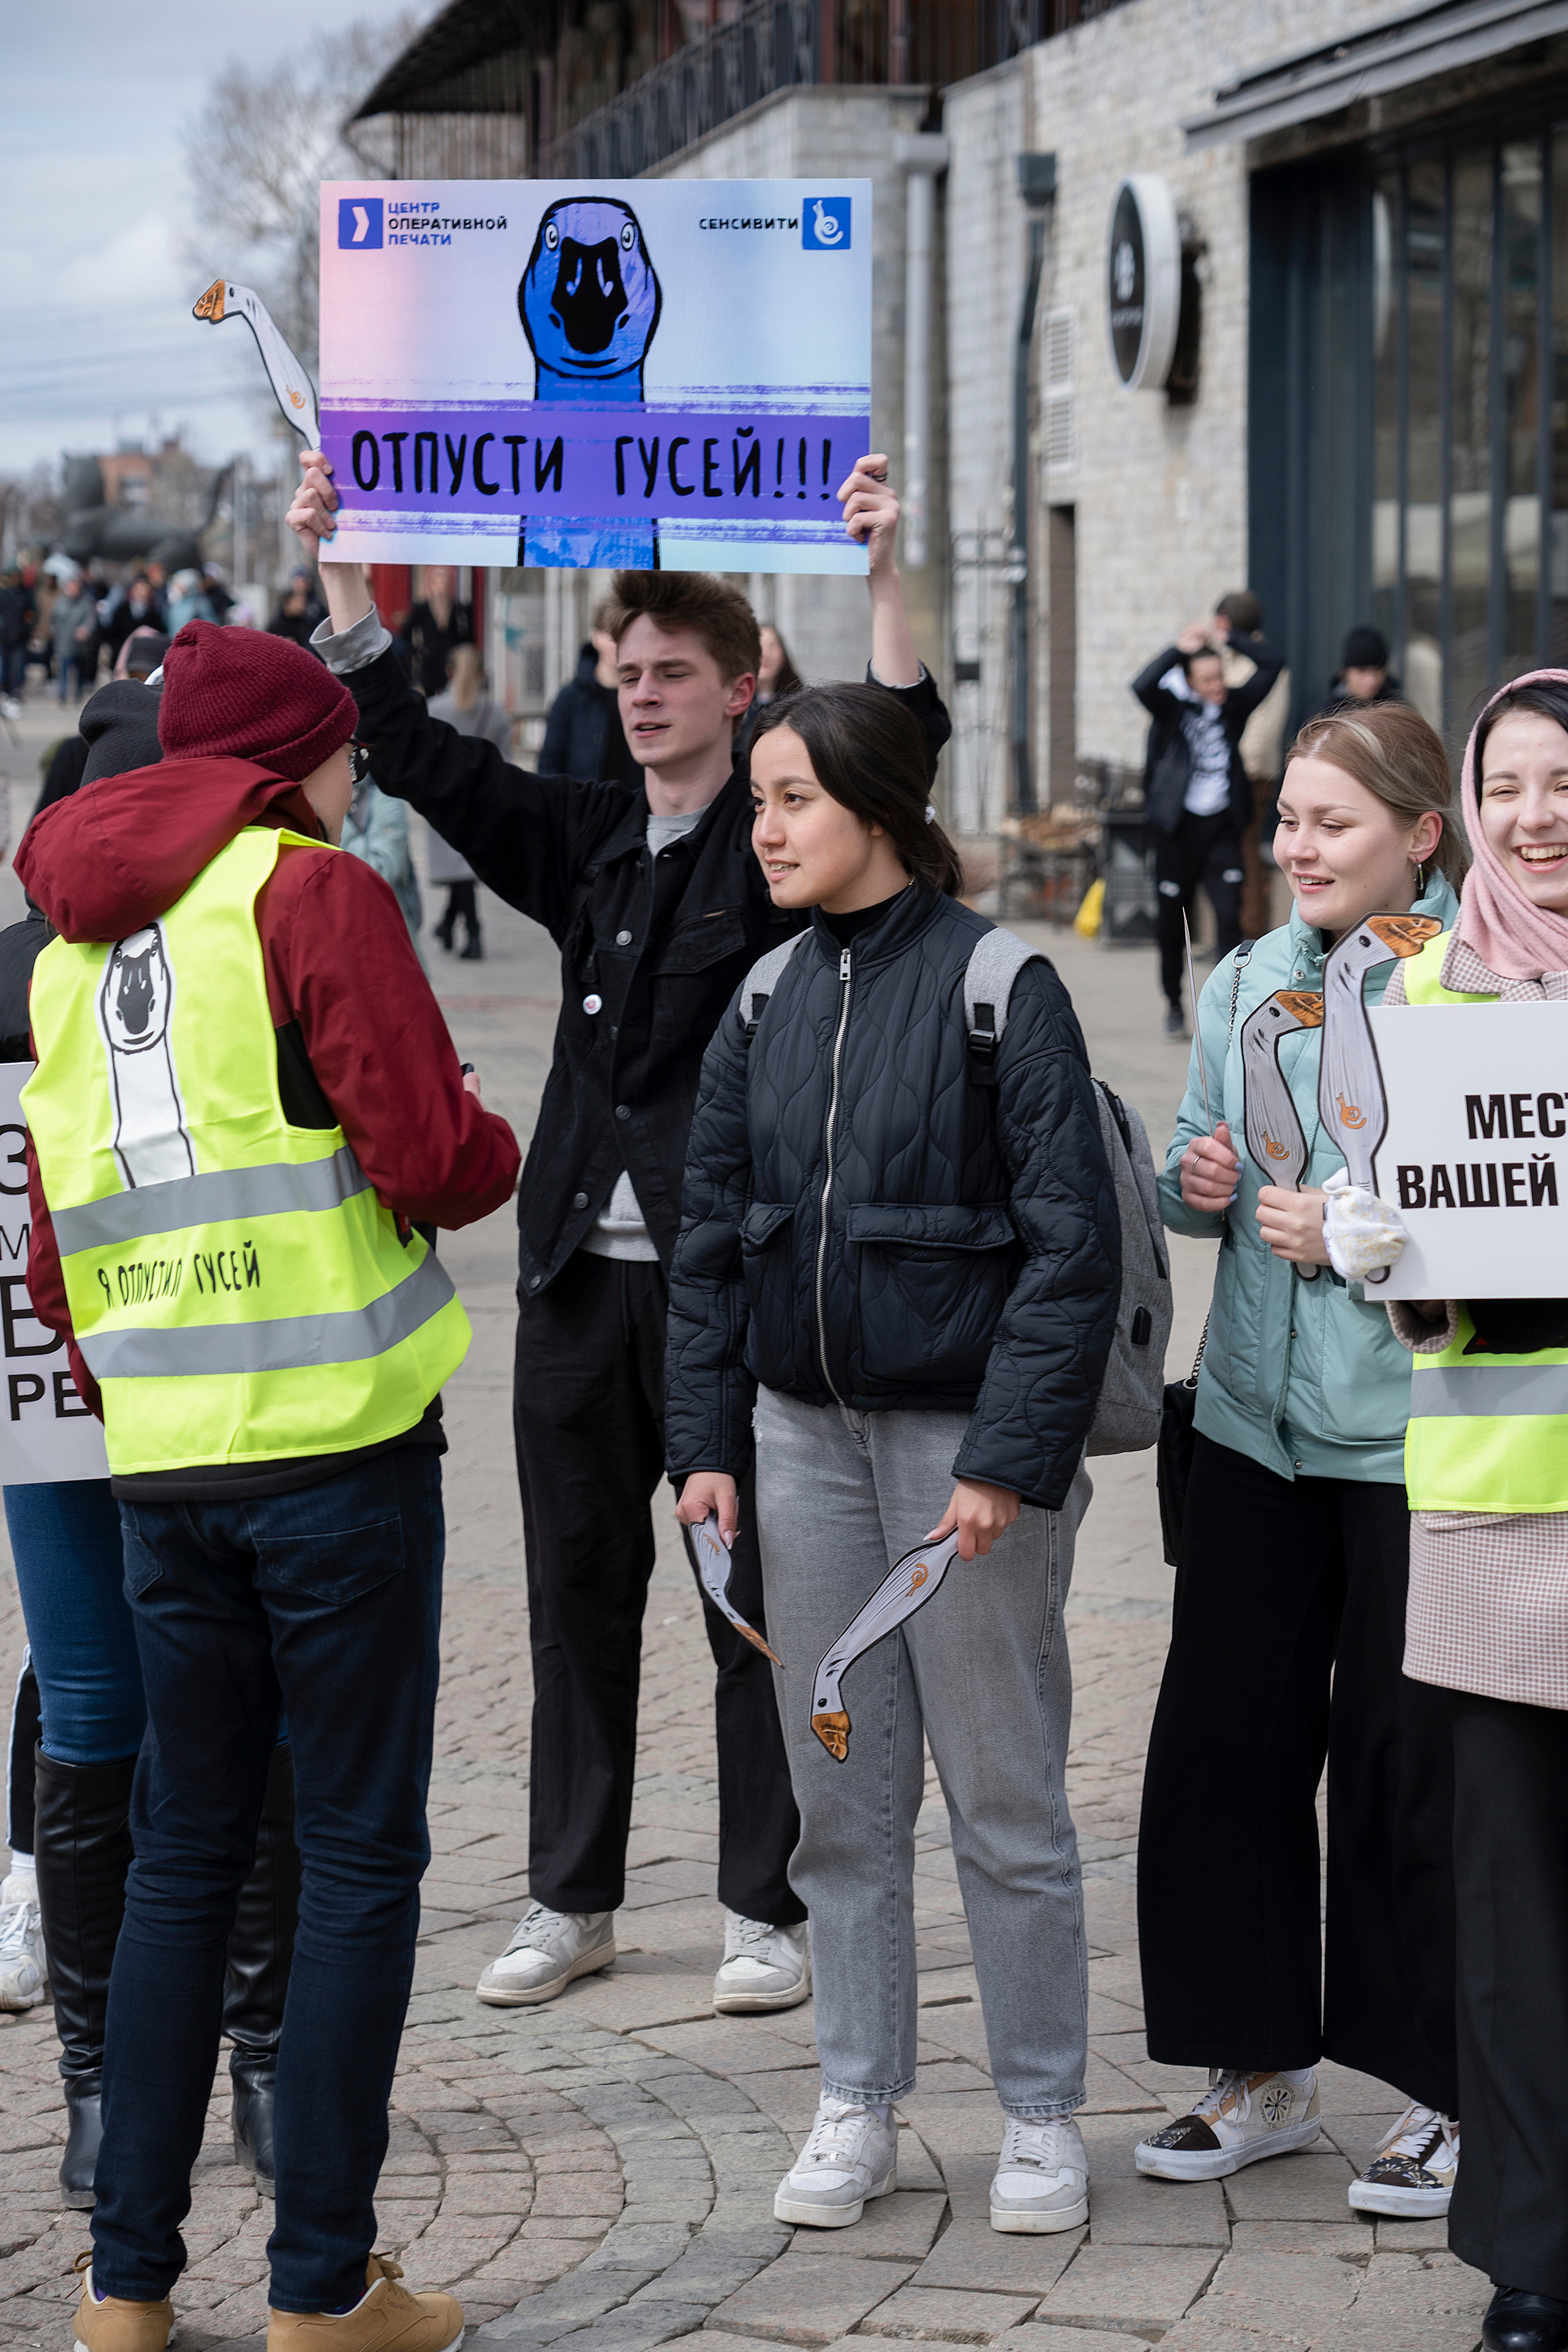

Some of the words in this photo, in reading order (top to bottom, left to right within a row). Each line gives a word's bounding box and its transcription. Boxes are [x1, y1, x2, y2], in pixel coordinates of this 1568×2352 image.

[388, 203, 440, 215] ЦЕНТР
[388, 216, 508, 230] ОПЕРАТИВНОЙ
[699, 218, 799, 230] СЕНСИВИТИ
[388, 234, 451, 245] ПЕЧАТИ
[352, 430, 564, 496] ОТПУСТИ
[615, 426, 831, 500] ГУСЕЙ!!!
[1464, 1093, 1568, 1140] МЕС
[1396, 1153, 1559, 1210] ВАШЕЙ
[97, 1268, 115, 1309] Я
[118, 1258, 182, 1307] ОТПУСТИЛ
[194, 1240, 260, 1294] ГУСЕЙ
